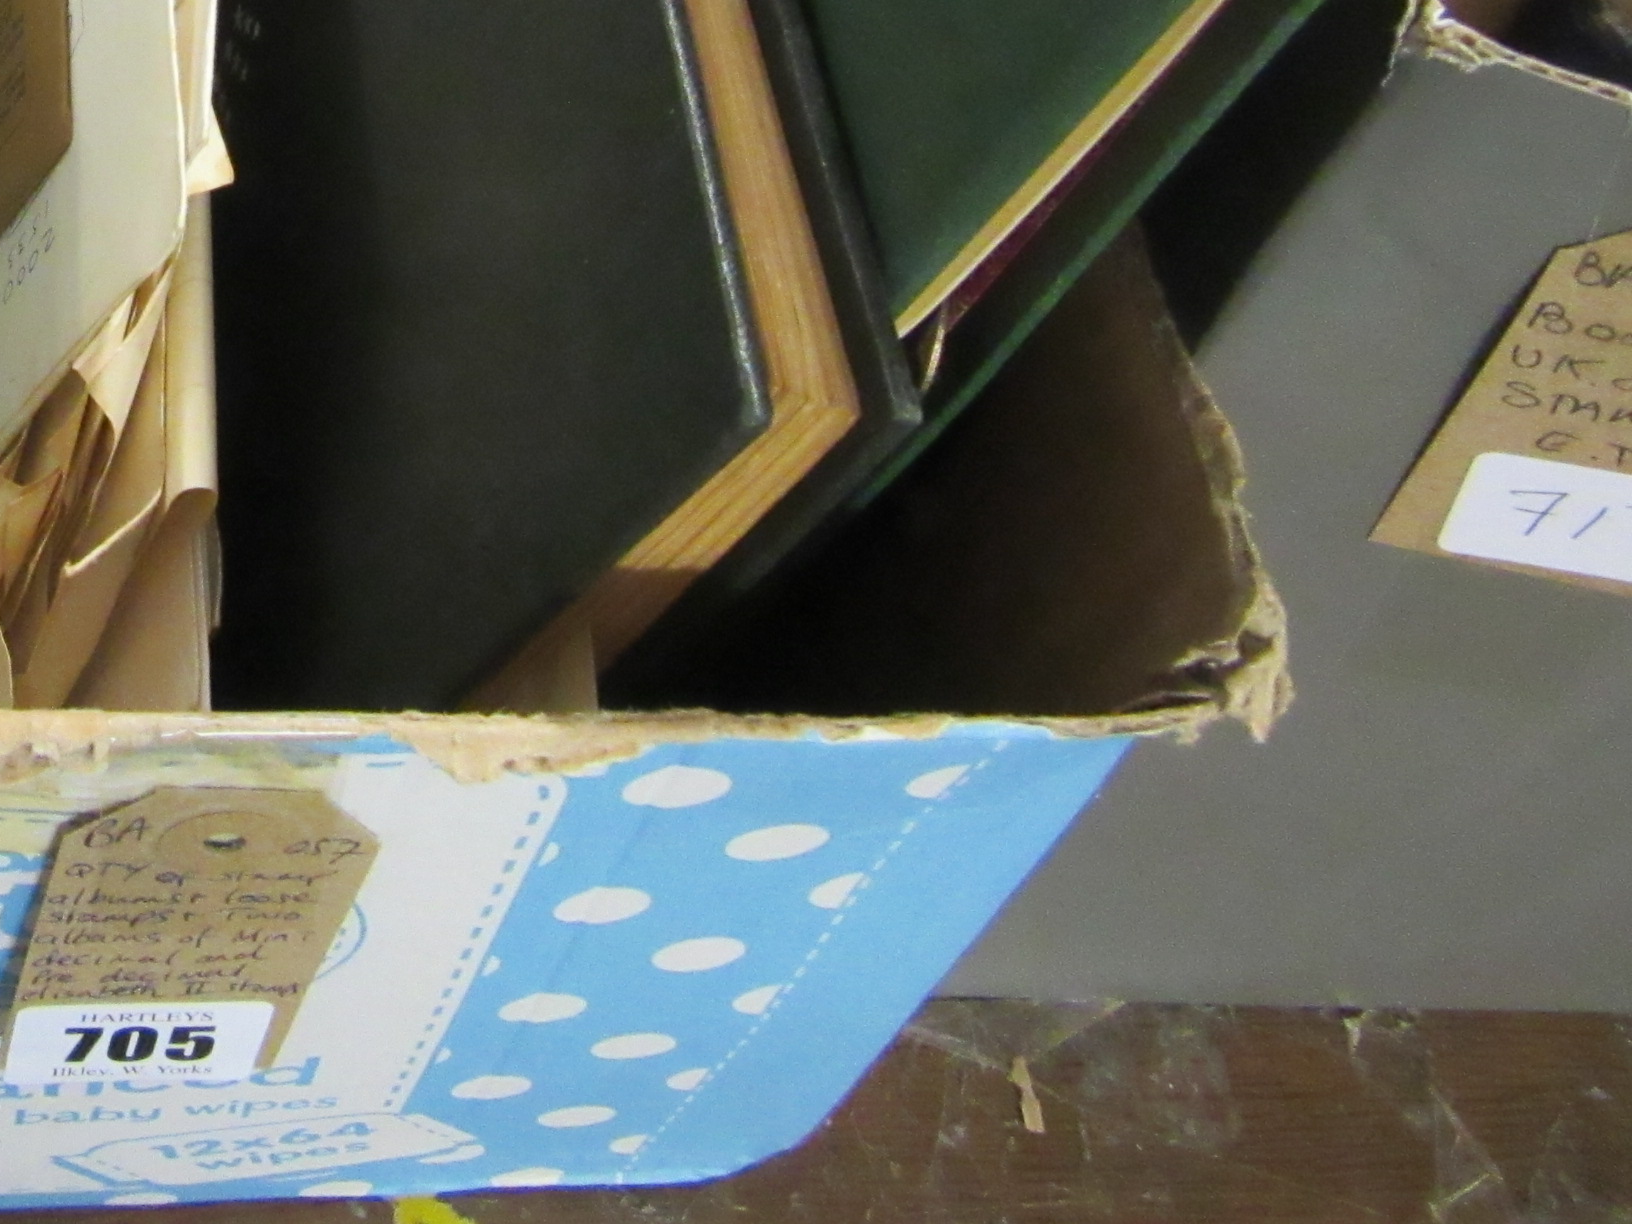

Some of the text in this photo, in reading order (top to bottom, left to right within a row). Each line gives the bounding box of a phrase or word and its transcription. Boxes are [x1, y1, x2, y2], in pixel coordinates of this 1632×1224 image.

[1509, 490, 1632, 540] 71
[80, 1010, 215, 1023] HARTLEYS
[64, 1025, 217, 1063] 705
[157, 1063, 213, 1075] Yorks
[13, 1103, 163, 1128] baby
[184, 1094, 340, 1118] wipes
[195, 1141, 371, 1171] wipes
